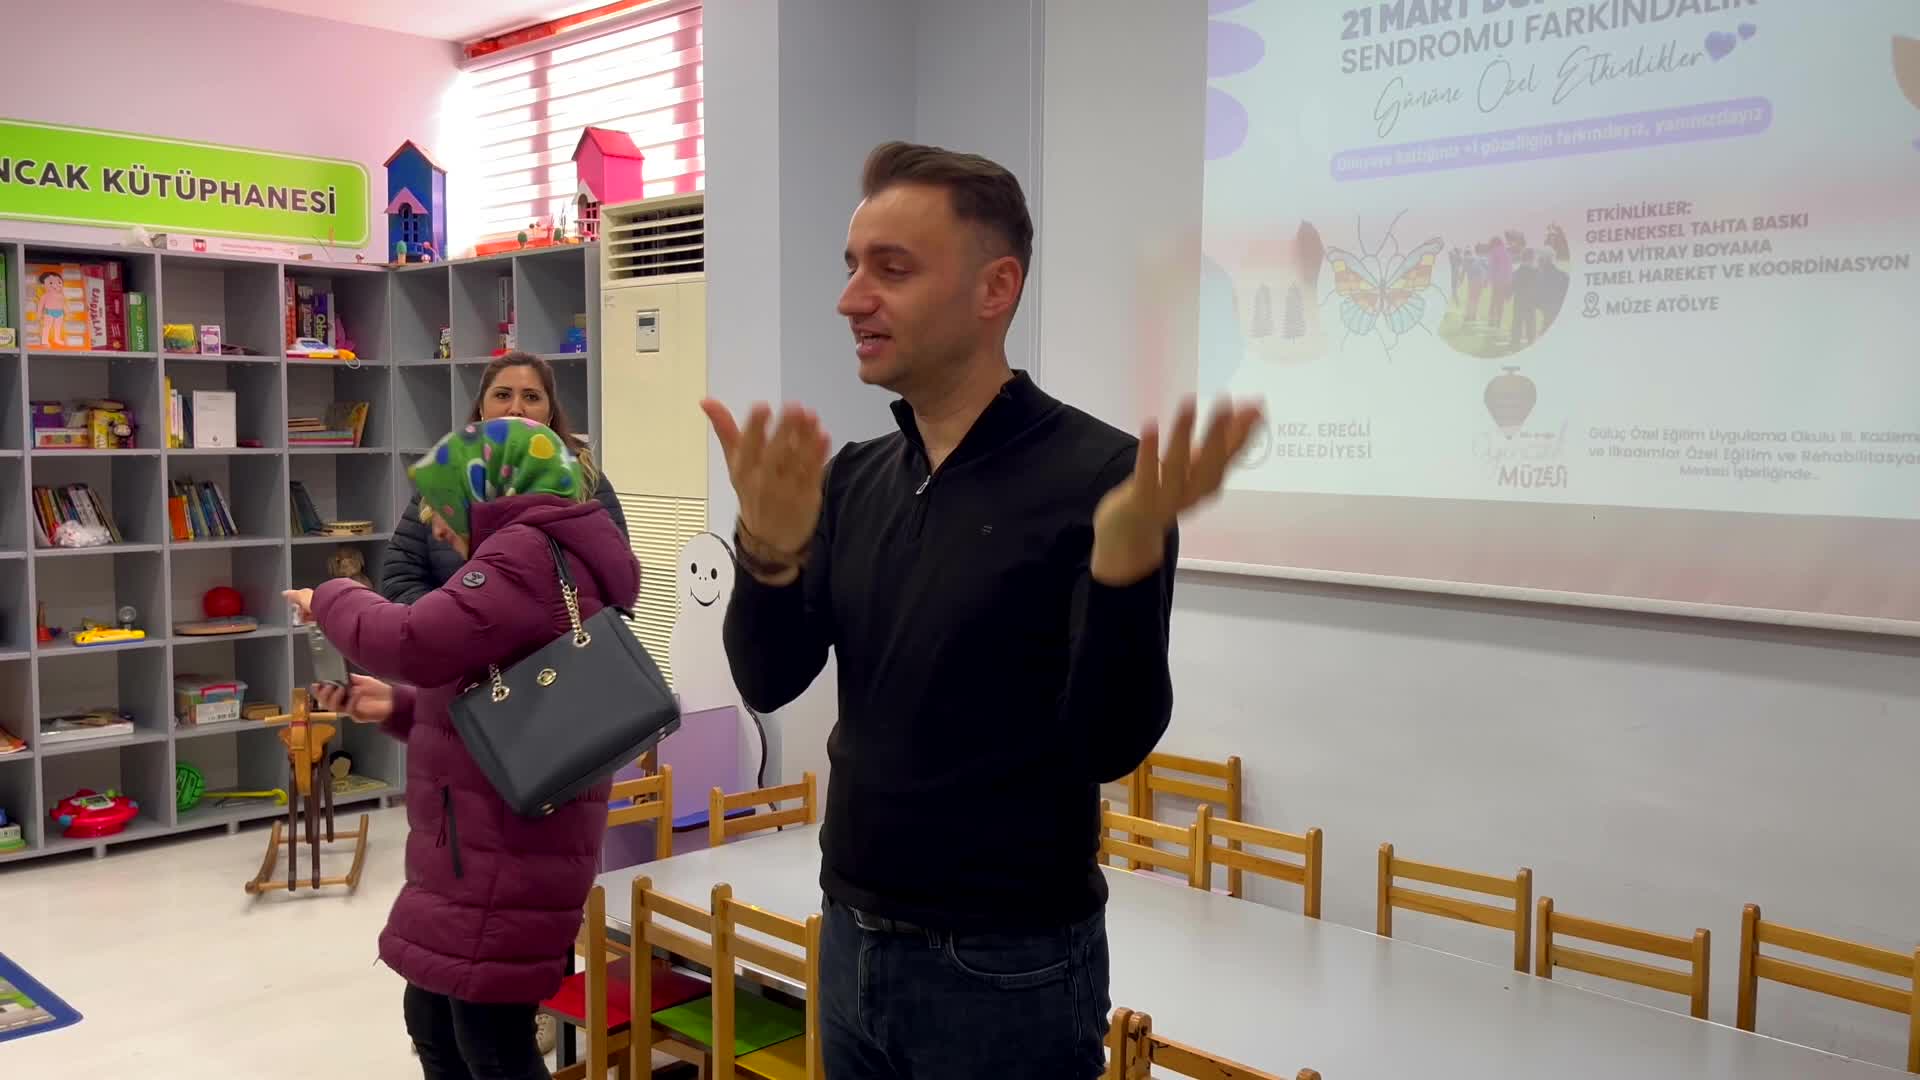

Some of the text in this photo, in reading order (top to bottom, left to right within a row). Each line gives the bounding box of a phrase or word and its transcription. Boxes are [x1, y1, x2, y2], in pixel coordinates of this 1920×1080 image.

[1341, 7, 1371, 40] 21
[1341, 19, 1513, 74] SENDROMU
[1374, 40, 1704, 138] Gününe Özel Etkinlikler
[103, 164, 336, 215] KÜTÜPHANESİ
[1585, 211, 1809, 244] GELENEKSEL TAHTA BASKI
[1586, 200, 1692, 224] ETKİNLİKLER:
[1584, 238, 1773, 265] CAM VİTRAY BOYAMA
[1584, 252, 1911, 287] TEMEL HAREKET VE KOORDİNASYON
[1605, 293, 1719, 316] MÜZE ATÖLYE
[1277, 440, 1373, 459] BELEDİYESİ
